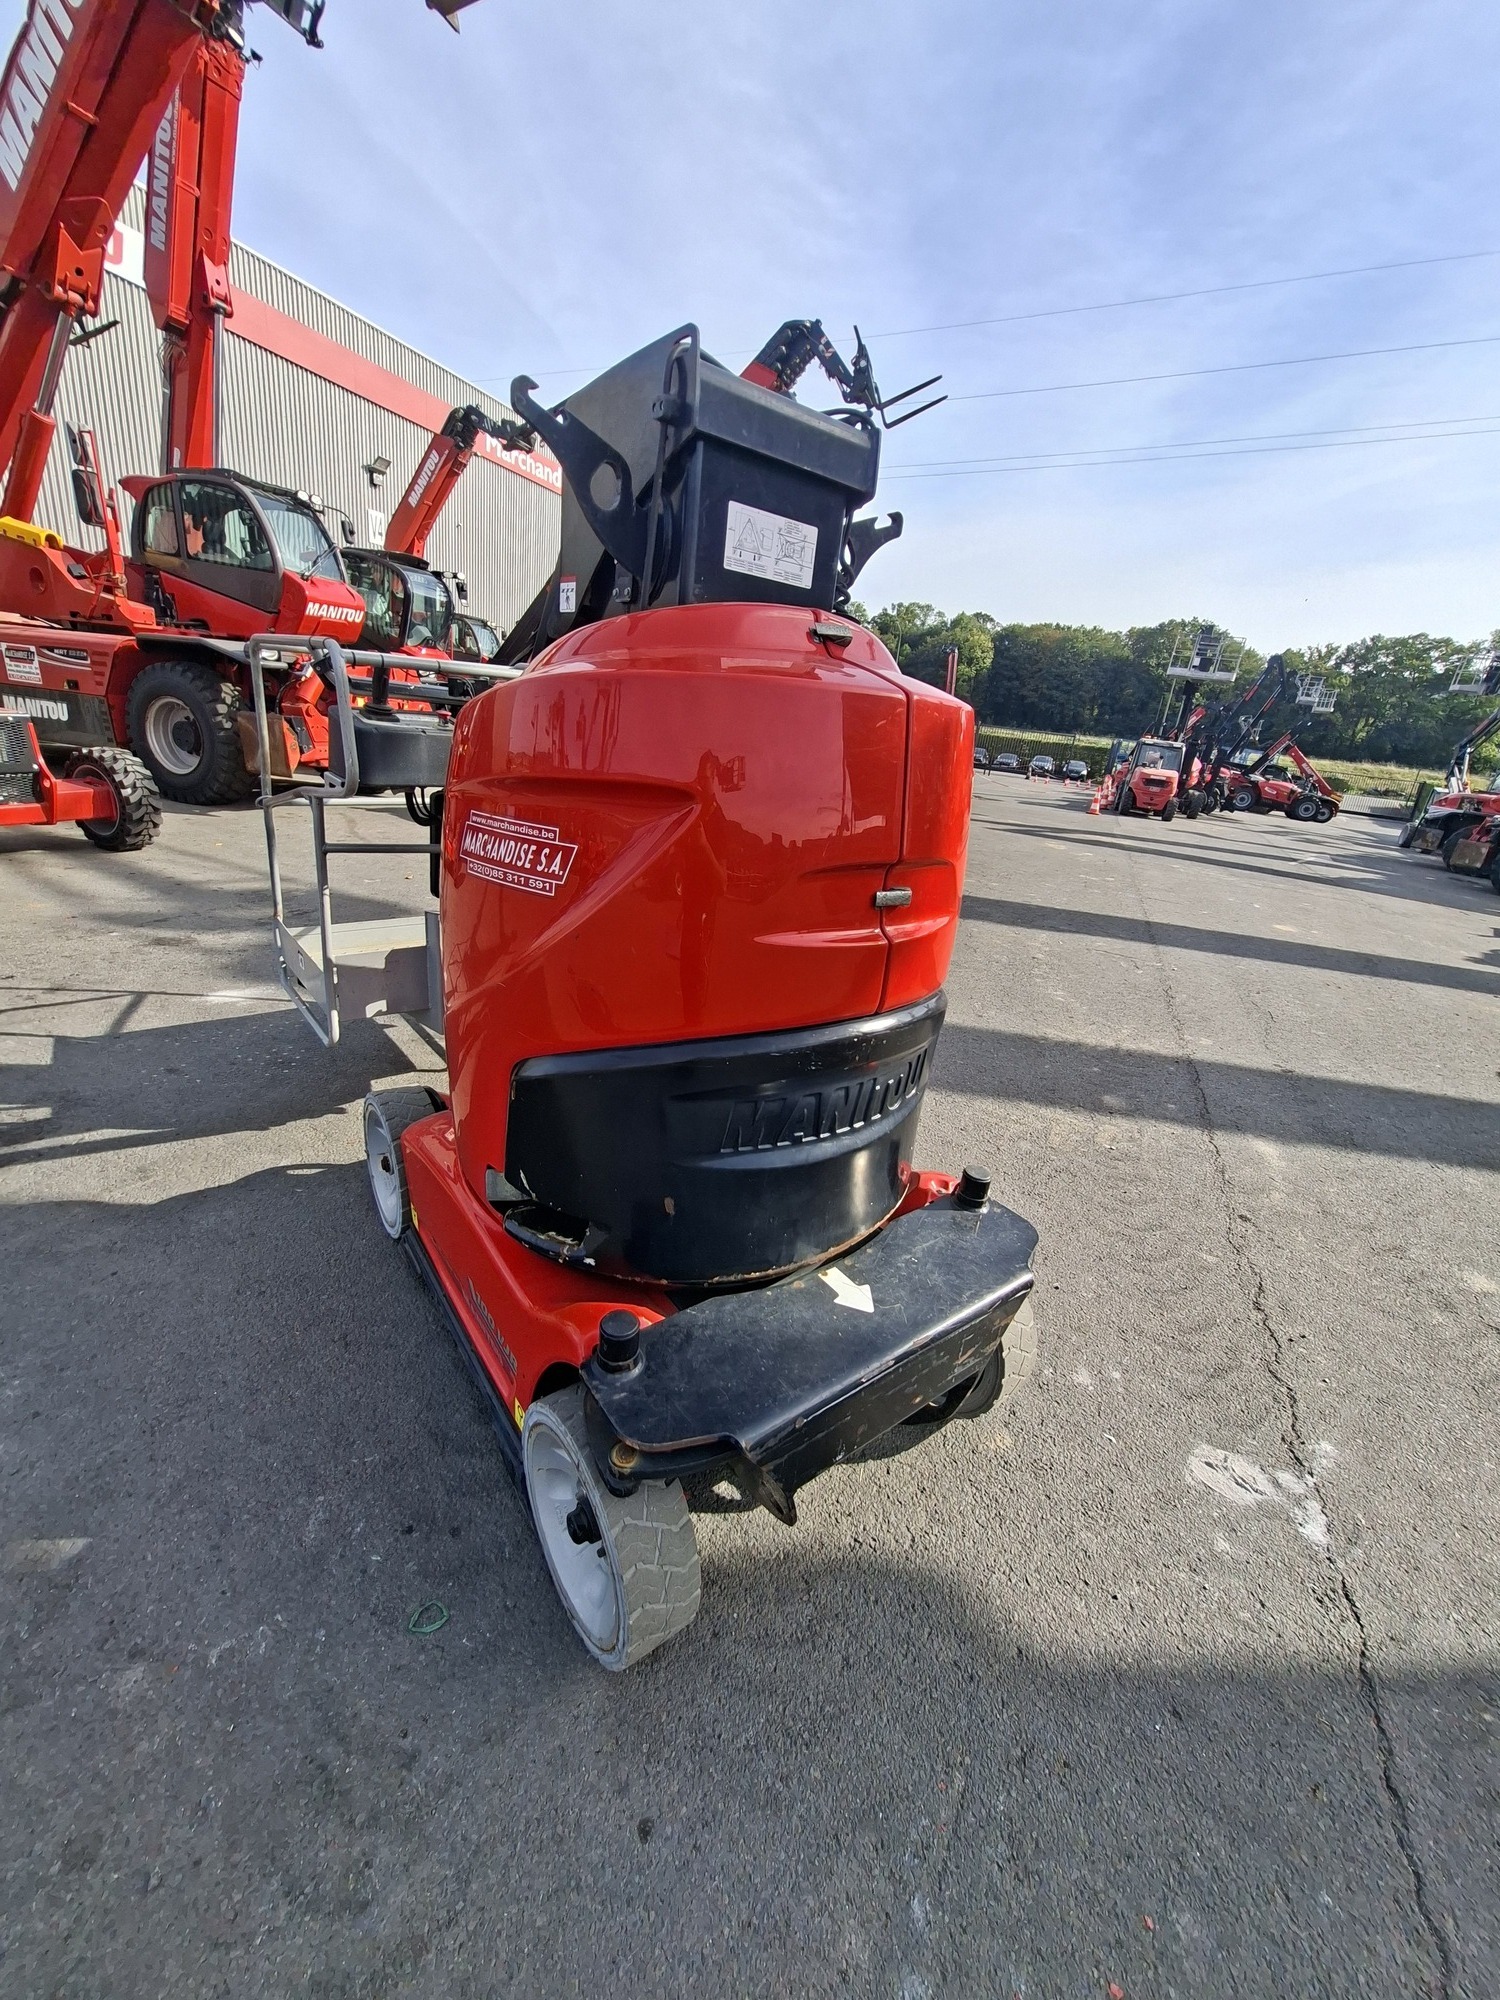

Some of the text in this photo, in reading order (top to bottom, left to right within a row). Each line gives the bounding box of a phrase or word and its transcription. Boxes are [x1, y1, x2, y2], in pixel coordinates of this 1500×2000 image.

[0, 0, 83, 191] MANIT
[171, 83, 180, 164] www.marchand
[408, 449, 439, 508] MANITOU
[485, 433, 562, 488] Marchand
[369, 513, 383, 542] V4
[306, 602, 365, 623] MANITOU
[2, 694, 69, 721] MANITOU
[472, 815, 555, 839] www.marchandise.be
[464, 830, 564, 875] MARCHANDISE S.A.
[469, 862, 550, 891] +32(0)85 311 591
[720, 1048, 928, 1152] MANITOU
